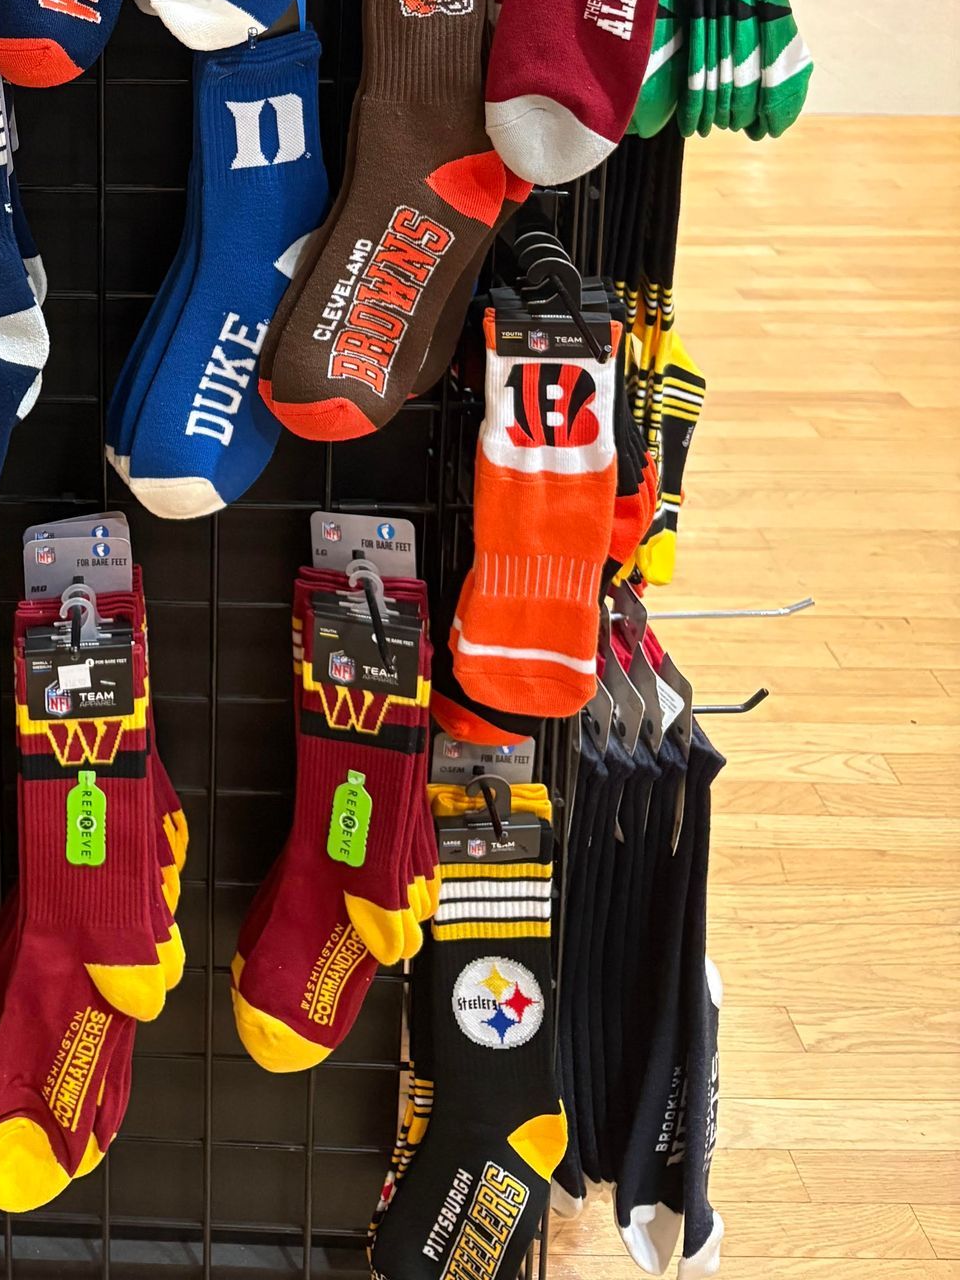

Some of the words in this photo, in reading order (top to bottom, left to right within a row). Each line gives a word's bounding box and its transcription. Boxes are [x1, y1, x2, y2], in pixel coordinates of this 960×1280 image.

[312, 238, 374, 342] CLEVELAND
[328, 205, 456, 399] BROWNS
[185, 311, 263, 447] DUKE
[77, 559, 89, 567] FOR
[91, 558, 110, 567] BARE
[111, 557, 127, 566] FEET
[361, 539, 374, 548] FOR
[375, 540, 394, 549] BARE
[395, 542, 411, 552] FEET
[79, 691, 114, 701] TEAM
[481, 754, 493, 763] FOR
[495, 754, 513, 763] BARE
[514, 755, 530, 764] FEET
[80, 790, 93, 858] REPREVE
[340, 789, 358, 858] REPREVE
[491, 840, 516, 849] TEAM
[300, 922, 344, 1010] WASHINGTON
[313, 930, 366, 1026] COMMANDERS
[457, 995, 498, 1011] Steelers
[52, 1009, 107, 1128] COMMANDERS
[655, 1065, 682, 1152] BROOKLYN
[422, 1167, 474, 1262] PITTSBURGH
[440, 1160, 530, 1280] TEELERS
